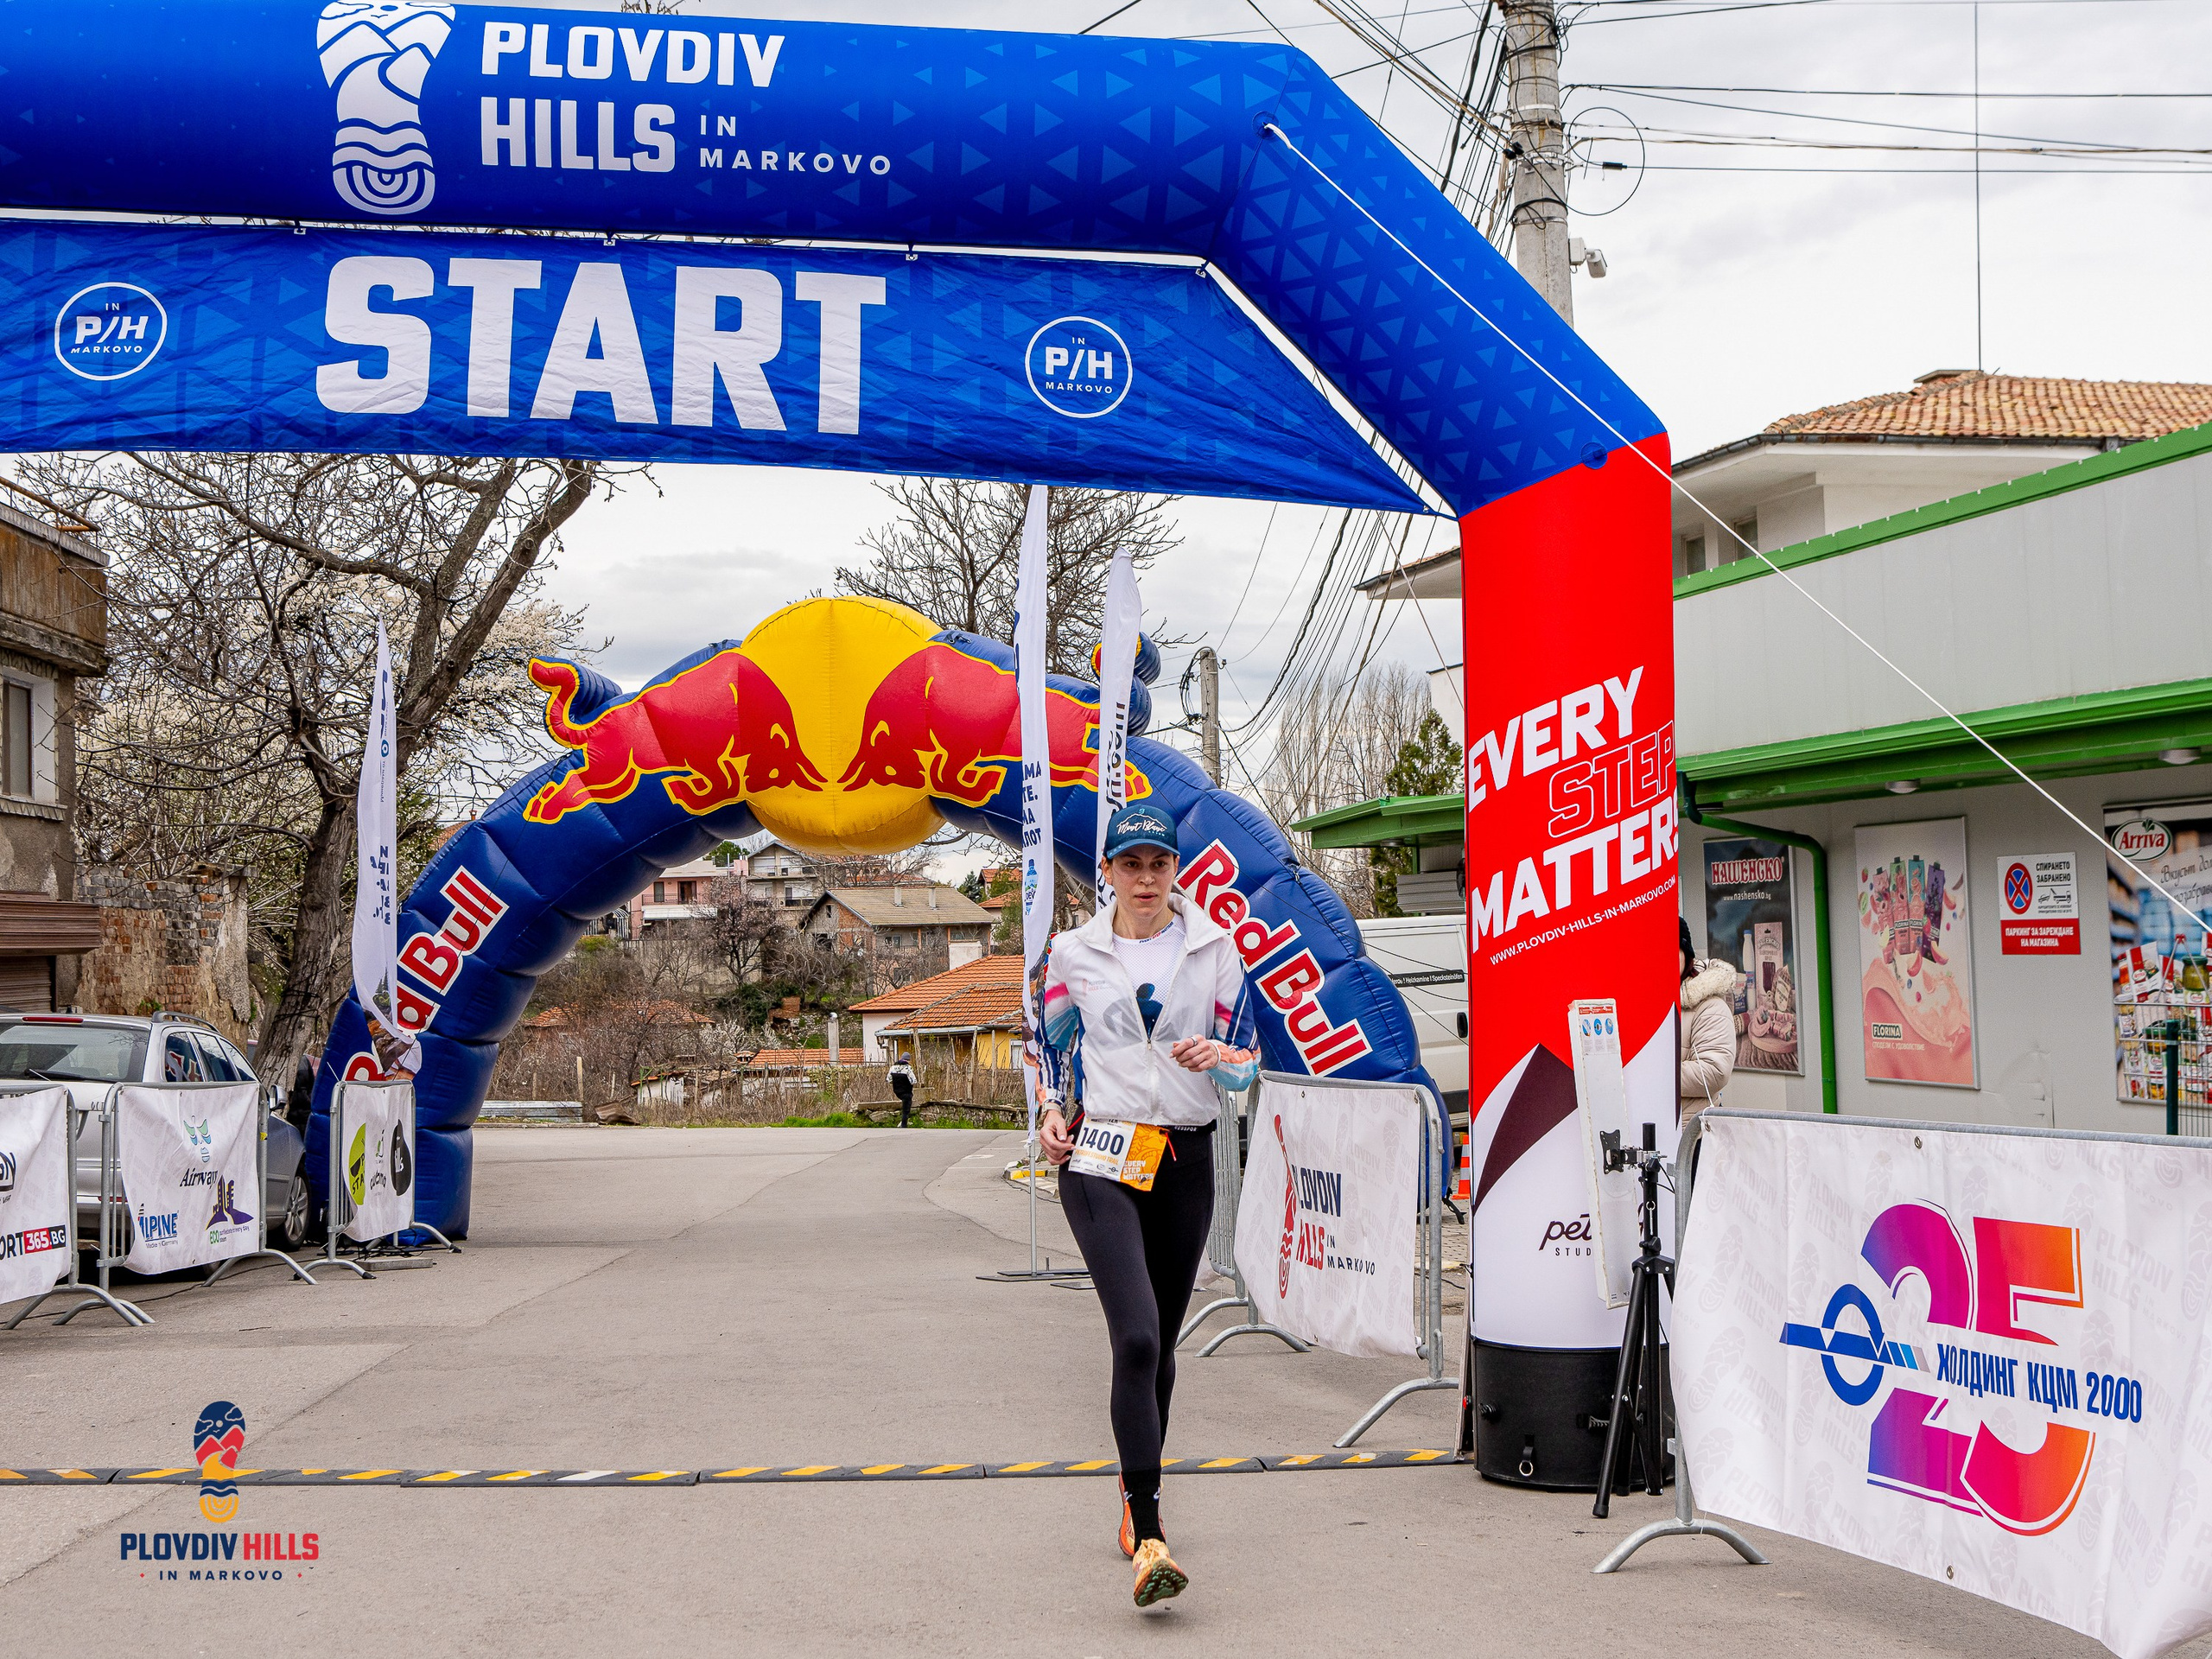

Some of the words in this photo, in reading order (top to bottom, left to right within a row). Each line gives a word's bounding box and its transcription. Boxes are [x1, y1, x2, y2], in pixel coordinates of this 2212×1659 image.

[481, 22, 785, 87] PLOVDIV
[480, 97, 676, 173] HILLS
[701, 115, 736, 137] IN
[700, 148, 892, 175] MARKOVO
[105, 302, 120, 311] IN
[75, 315, 149, 345] P/H
[70, 346, 143, 354] MARKOVO
[316, 257, 887, 435] START
[1045, 346, 1113, 380] P/H
[1046, 382, 1113, 394] MARKOVO
[1469, 665, 1644, 813] EVERY
[1548, 719, 1675, 838] STEP
[2119, 832, 2165, 850] Arriva
[1712, 857, 1783, 885] НАШЕНСКО
[2036, 861, 2070, 872] СПИРАНЕТО
[2037, 873, 2071, 883] ЗАБРАНЕНО
[398, 869, 505, 991] Bull
[1490, 874, 1676, 966] WWW.PLOVDIV-HILLS-IN-MARKOVO.COM
[2005, 927, 2031, 936] ПАРКИНГ
[2020, 938, 2030, 947] НА
[1175, 841, 1298, 971] Red
[1258, 950, 1370, 1075] Bull
[1872, 1025, 1901, 1037] FLORINA
[1080, 1127, 1125, 1156] 1400
[1327, 1234, 1336, 1249] IN
[1555, 1247, 1592, 1256] STUD
[1327, 1255, 1376, 1276] MARKOVO
[1936, 1343, 2018, 1399] ХОЛДИНГ
[2026, 1361, 2079, 1414] КЦМ
[2086, 1371, 2143, 1424] 2000
